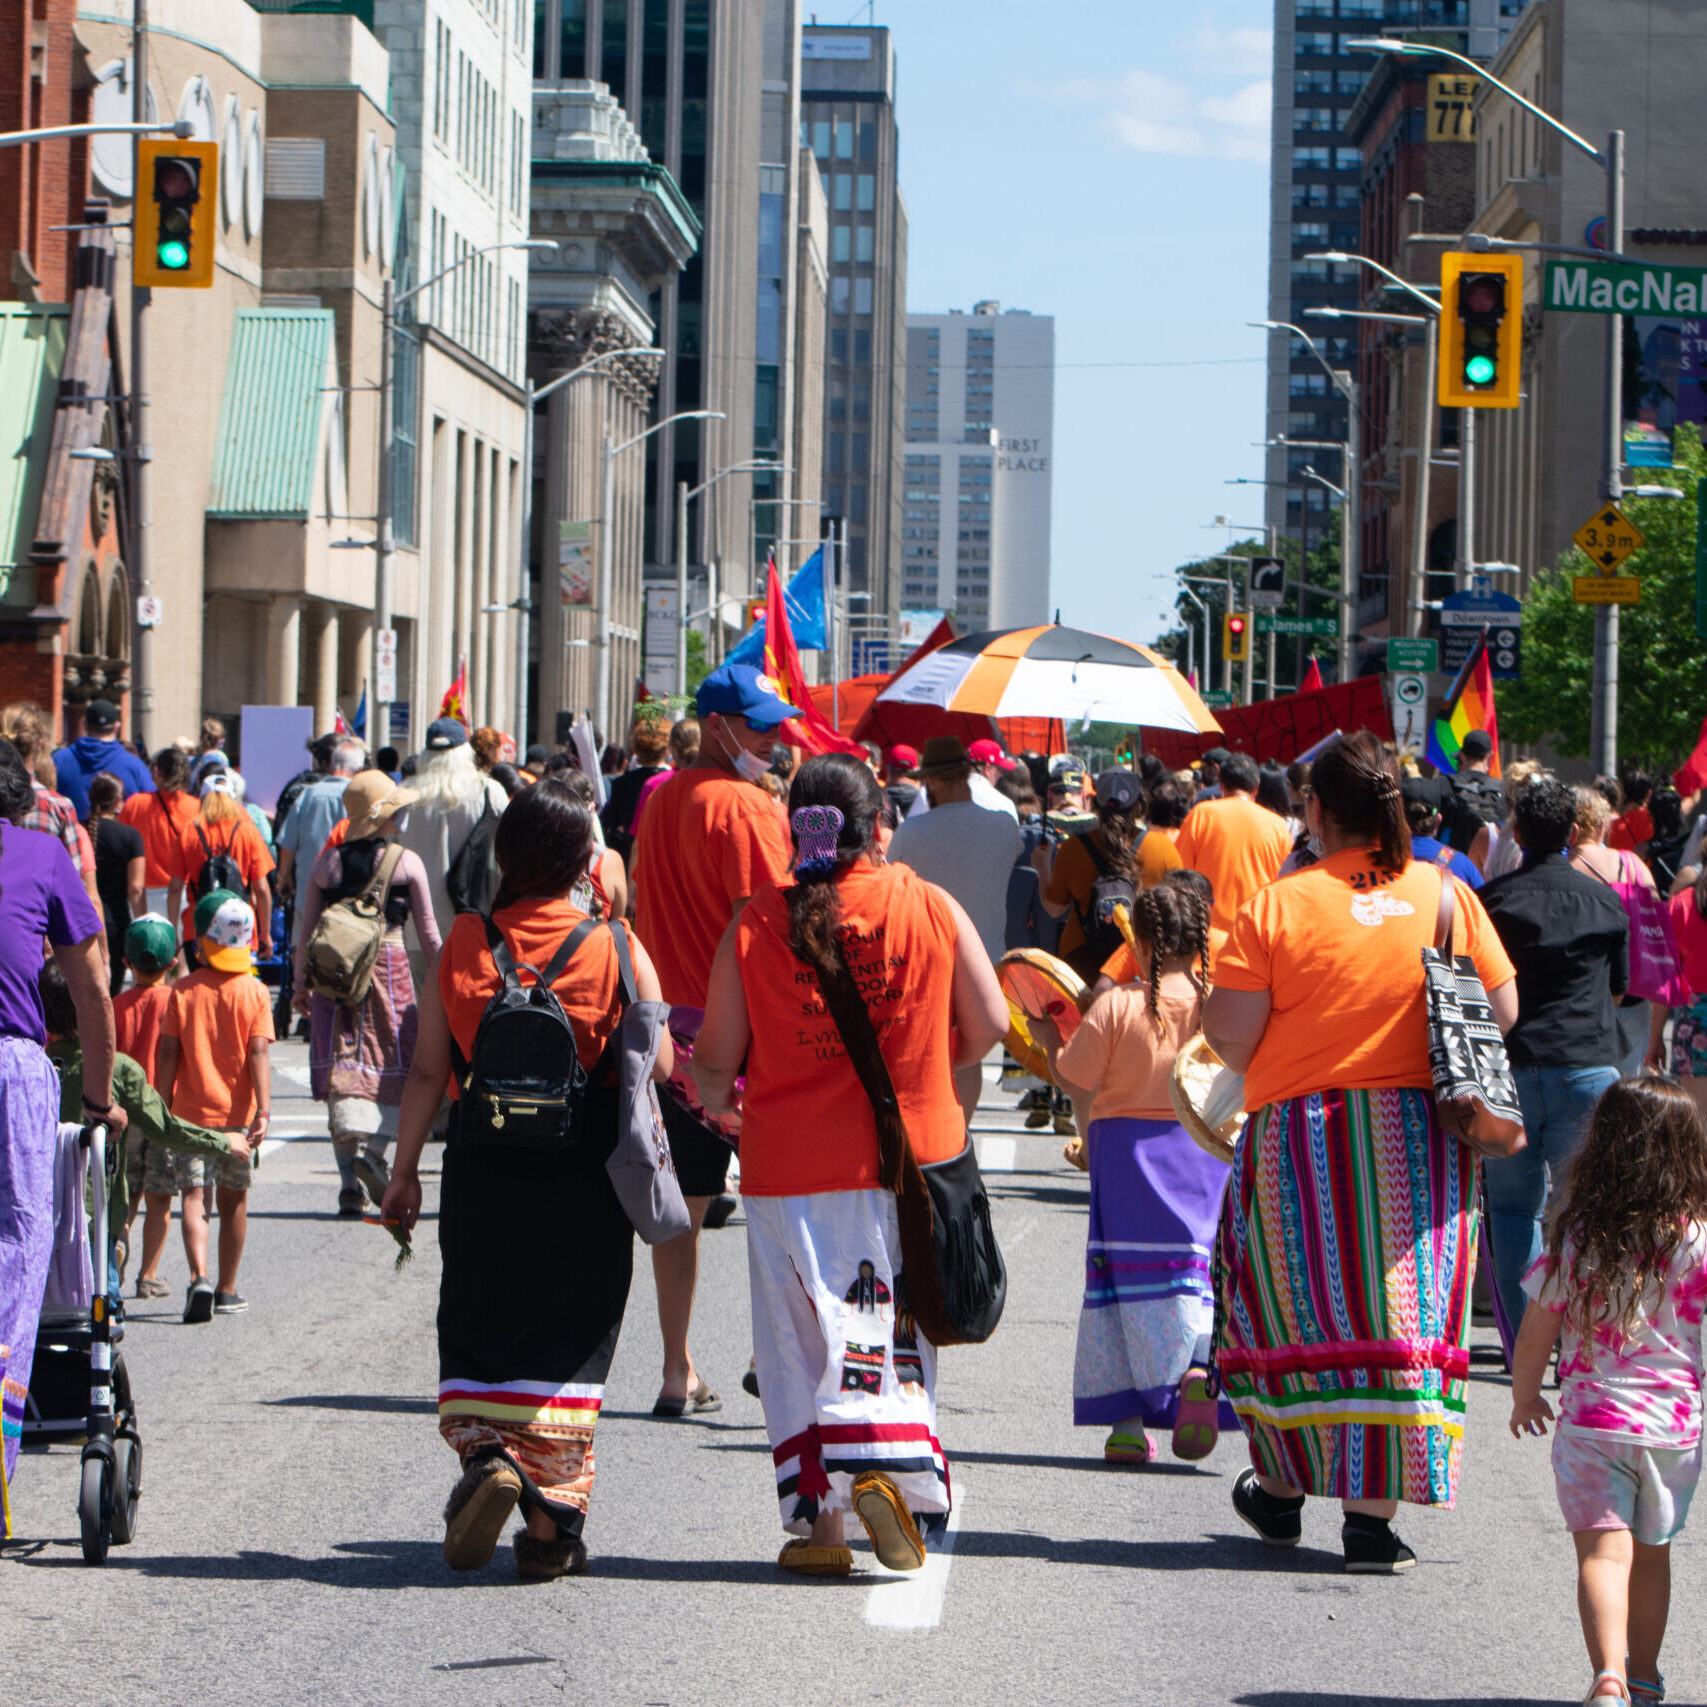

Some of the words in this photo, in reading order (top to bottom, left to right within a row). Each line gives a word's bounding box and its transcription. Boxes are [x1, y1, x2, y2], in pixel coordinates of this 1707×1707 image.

[998, 438, 1039, 453] FIRST
[998, 457, 1049, 472] PLACE
[1268, 619, 1313, 633] James
[1327, 620, 1337, 633] S
[1452, 613, 1510, 624] Downtown
[1350, 869, 1394, 889] 215
[794, 954, 908, 985] REENTIAL
